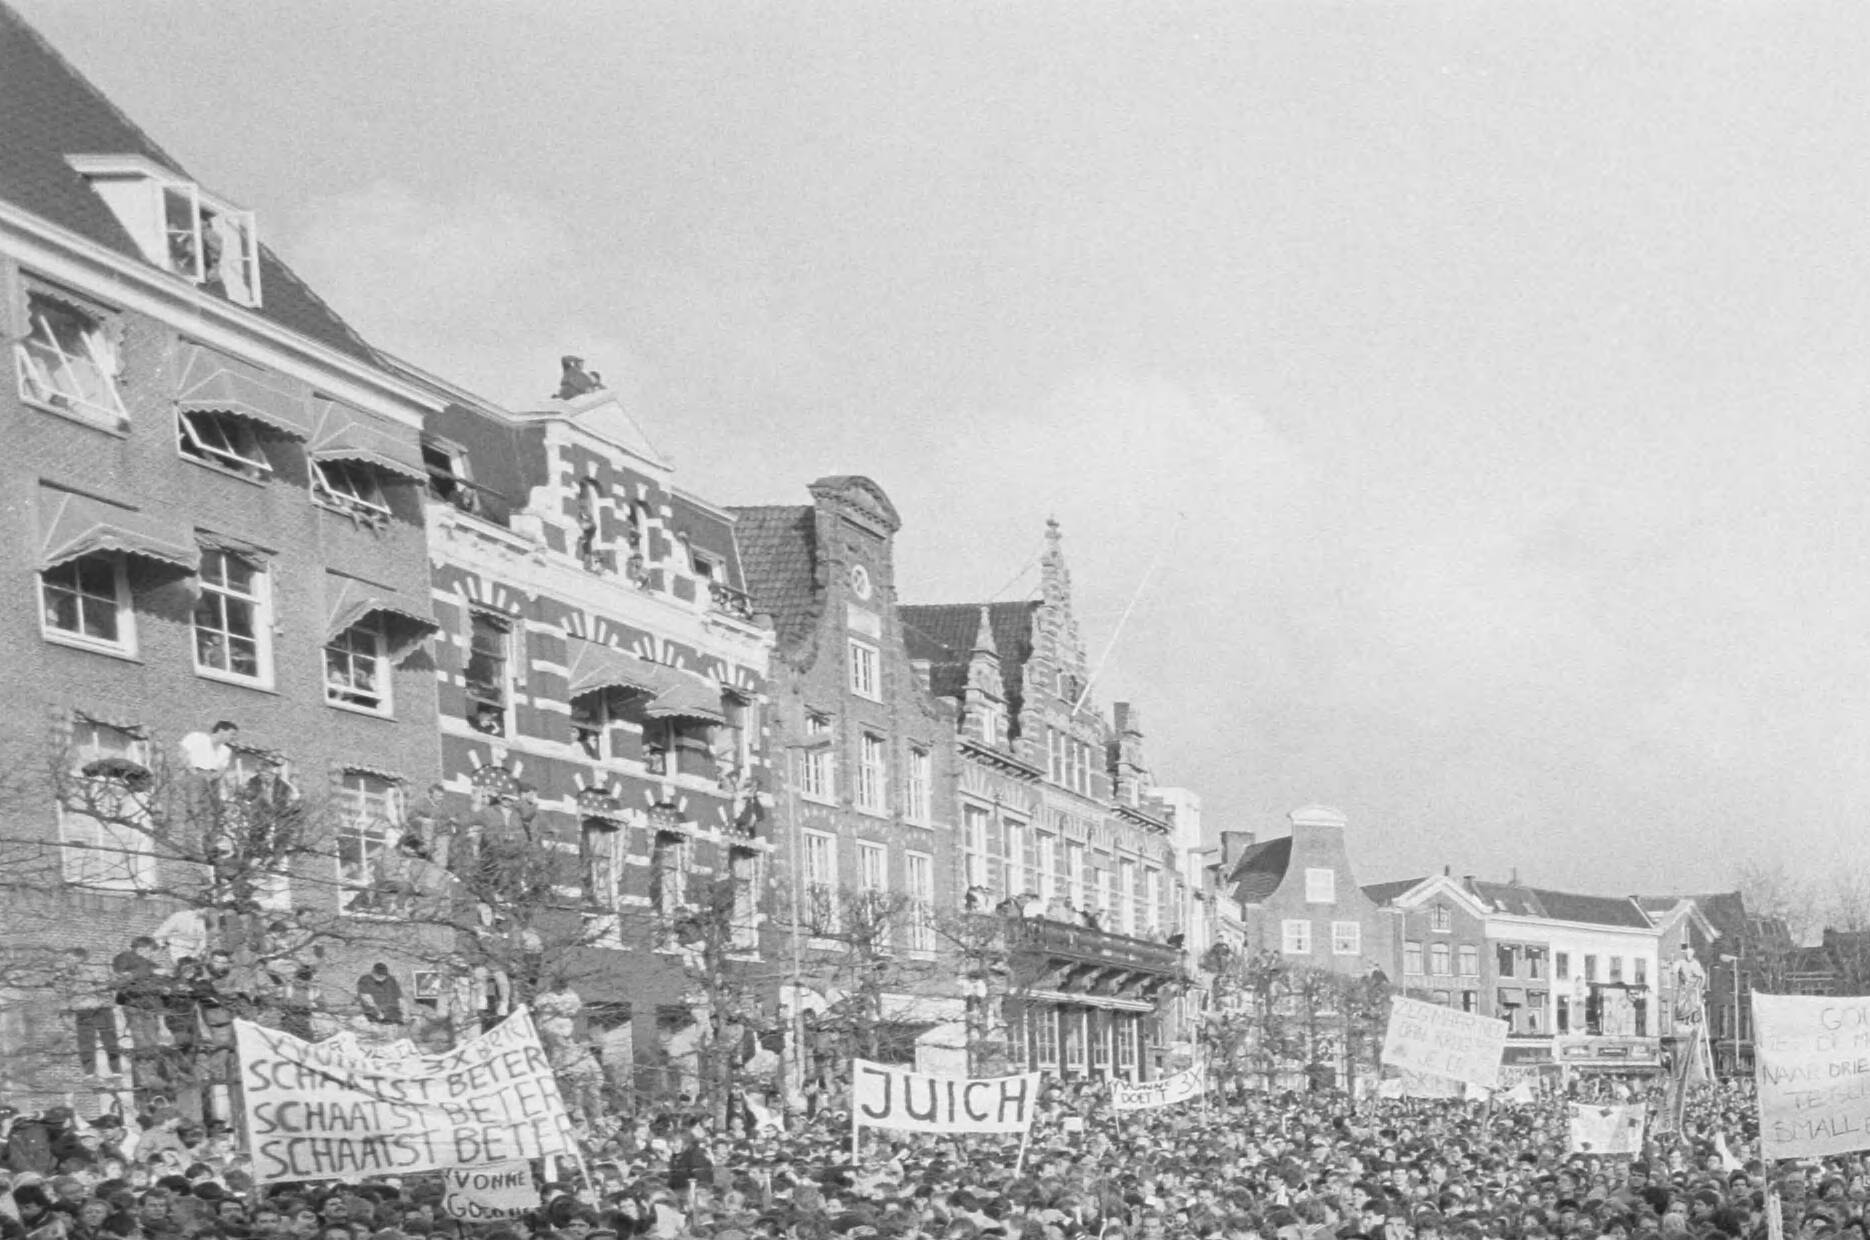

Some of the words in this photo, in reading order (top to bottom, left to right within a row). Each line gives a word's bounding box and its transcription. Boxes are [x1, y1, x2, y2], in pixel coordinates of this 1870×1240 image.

[448, 1045, 550, 1098] BETER
[861, 1066, 1027, 1123] JUICH
[254, 1099, 437, 1135] SCHAATST
[260, 1129, 441, 1179] SCHAATST
